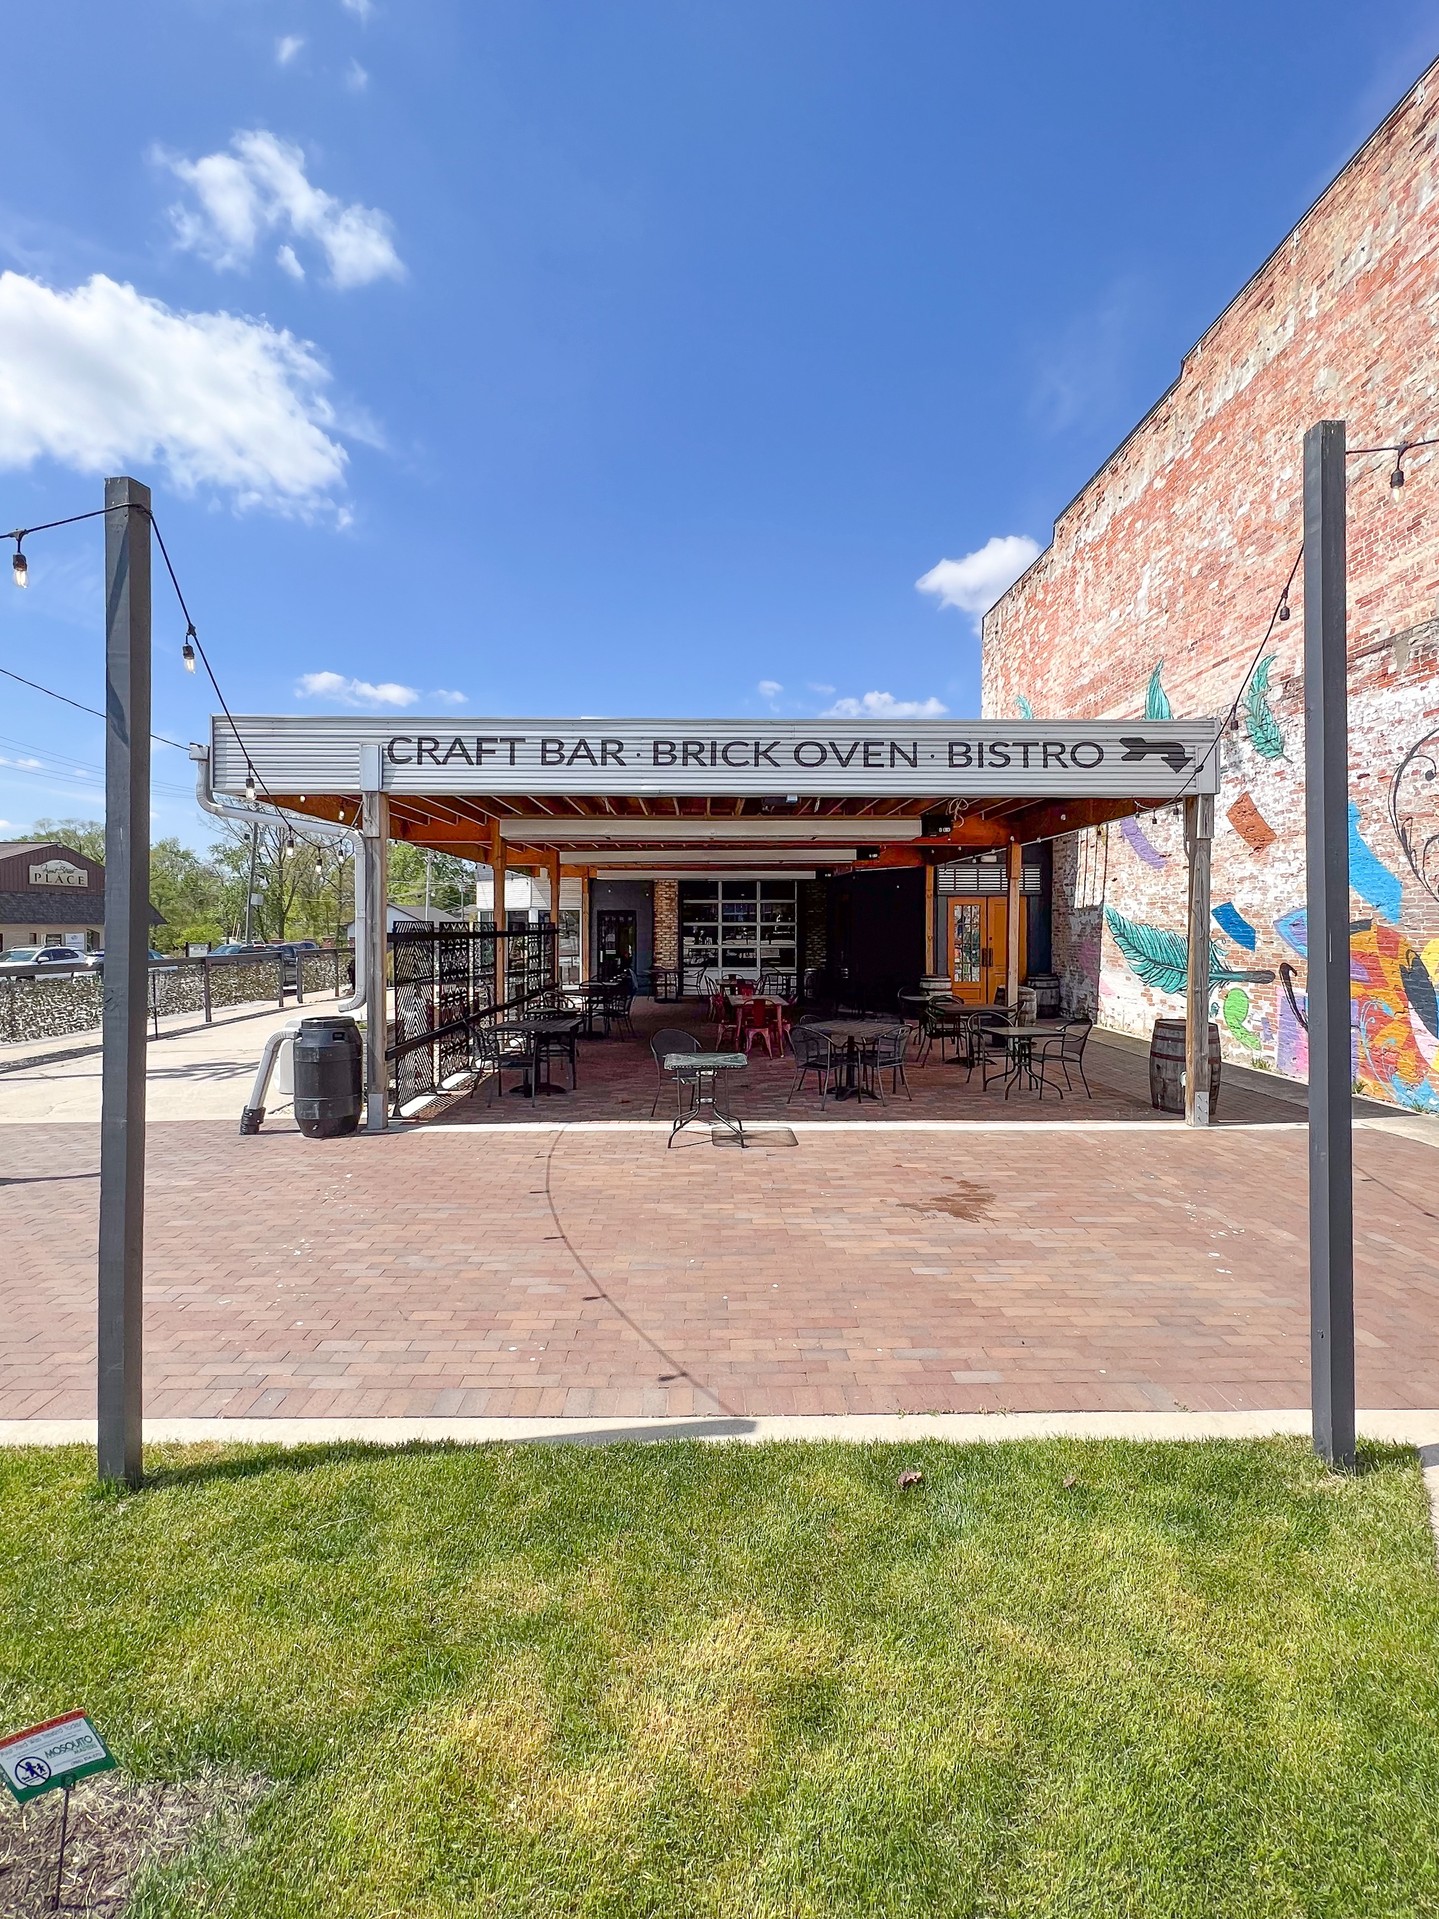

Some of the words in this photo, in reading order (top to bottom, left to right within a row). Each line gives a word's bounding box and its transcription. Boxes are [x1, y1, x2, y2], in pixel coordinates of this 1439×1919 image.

[387, 737, 527, 766] CRAFT
[540, 738, 626, 766] BAR
[652, 739, 780, 767] BRICK
[793, 740, 918, 768] OVEN
[947, 740, 1104, 769] BISTRO
[34, 873, 86, 885] PLACE
[44, 1735, 93, 1760] MOSQUITO
